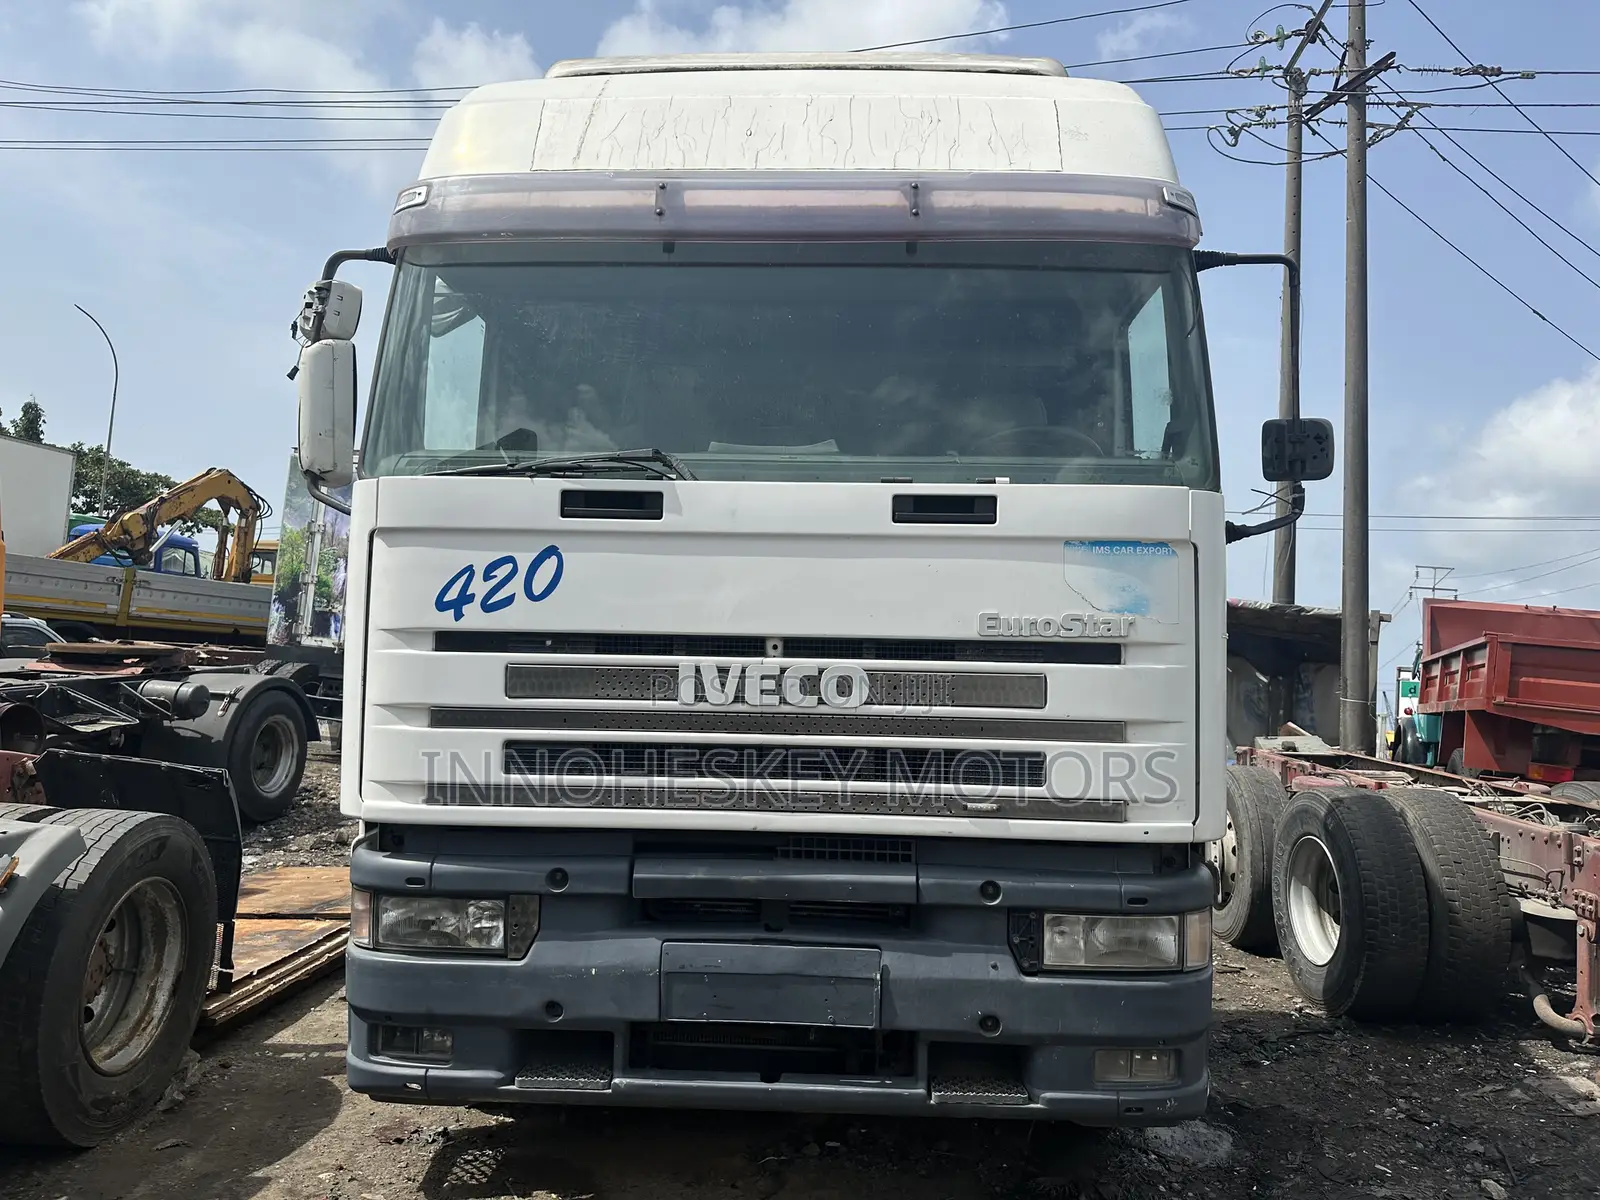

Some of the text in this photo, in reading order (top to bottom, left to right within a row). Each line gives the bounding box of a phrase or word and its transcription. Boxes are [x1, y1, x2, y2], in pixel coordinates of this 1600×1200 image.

[1092, 546, 1110, 555] IMS
[1113, 546, 1134, 555] CAR
[434, 544, 564, 622] 420
[977, 611, 1136, 638] EuroStar
[677, 662, 870, 708] IVECO
